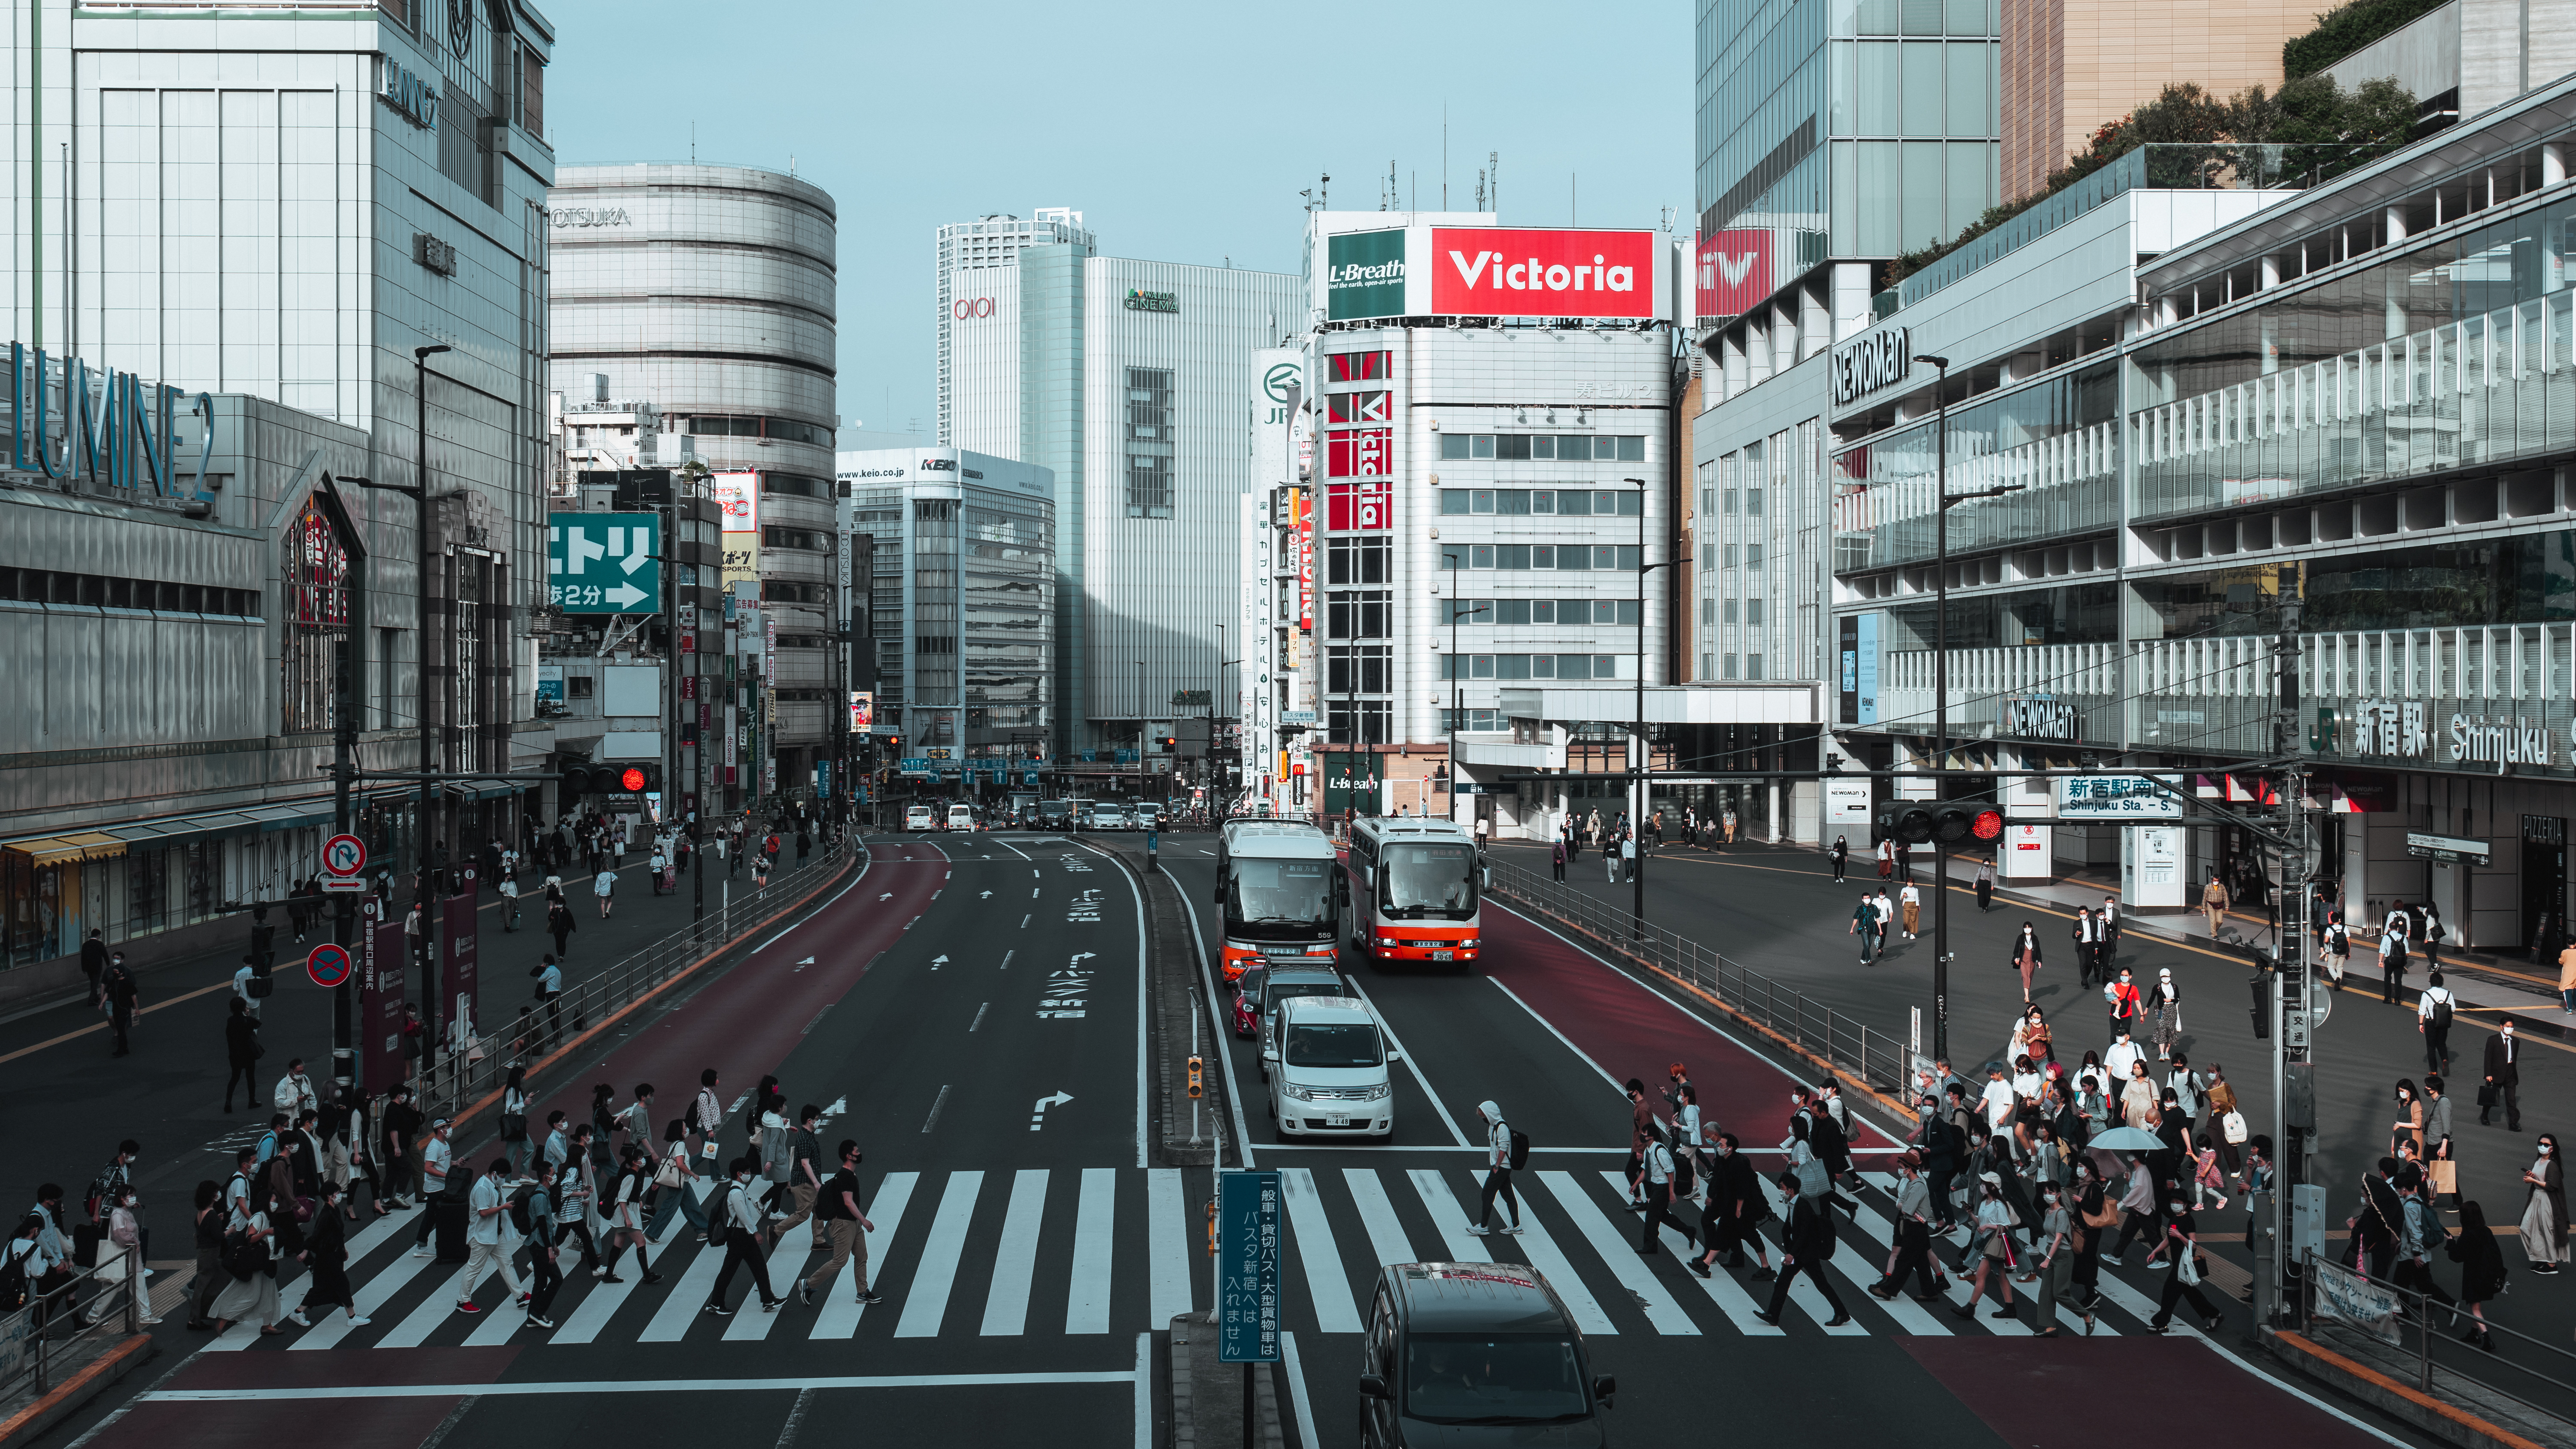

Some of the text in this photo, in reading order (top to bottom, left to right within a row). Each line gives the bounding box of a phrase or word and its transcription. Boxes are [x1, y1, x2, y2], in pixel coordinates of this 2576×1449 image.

[386, 52, 429, 123] LUMINE
[551, 207, 629, 226] OTSUKA
[1330, 259, 1405, 283] L-Breath
[1365, 278, 1386, 288] open-air
[1387, 277, 1403, 286] sports
[1449, 251, 1633, 292] Victoria
[1125, 298, 1179, 313] CINEMA
[1144, 291, 1176, 301] WALD 9
[1834, 327, 1908, 406] NEWoMan
[11, 340, 215, 504] LUMINE 2
[921, 459, 957, 471] KEIO
[1362, 392, 1384, 525] Victoria
[837, 467, 904, 479] www.keio.co.jp
[1019, 481, 1044, 493] www.keio.co.jp
[841, 548, 849, 586] OTSUKA
[1259, 501, 1268, 664] 豪華カプセルホテル
[736, 599, 759, 610] 広告募集
[1174, 696, 1213, 705] CINEMA
[1862, 697, 1874, 707] NEWoMan
[2011, 700, 2073, 739] NEWoMan
[2309, 699, 2553, 775] JR 新宿駅 Shinjuku
[2069, 778, 2172, 799] 新宿駅南口
[2069, 799, 2118, 812] Shinjuku
[2123, 800, 2144, 811] Sta.
[2160, 800, 2171, 811] S.
[2524, 816, 2562, 841] PIZZERIA
[366, 920, 374, 990] 新宿駅南口周辺案内
[2293, 1016, 2304, 1042] 交通
[1243, 1211, 1258, 1324] バスタ新宿へは
[1261, 1181, 1276, 1356] 一般車・貸切バス・大型貨物車は
[1226, 1276, 1241, 1356] 入れません
